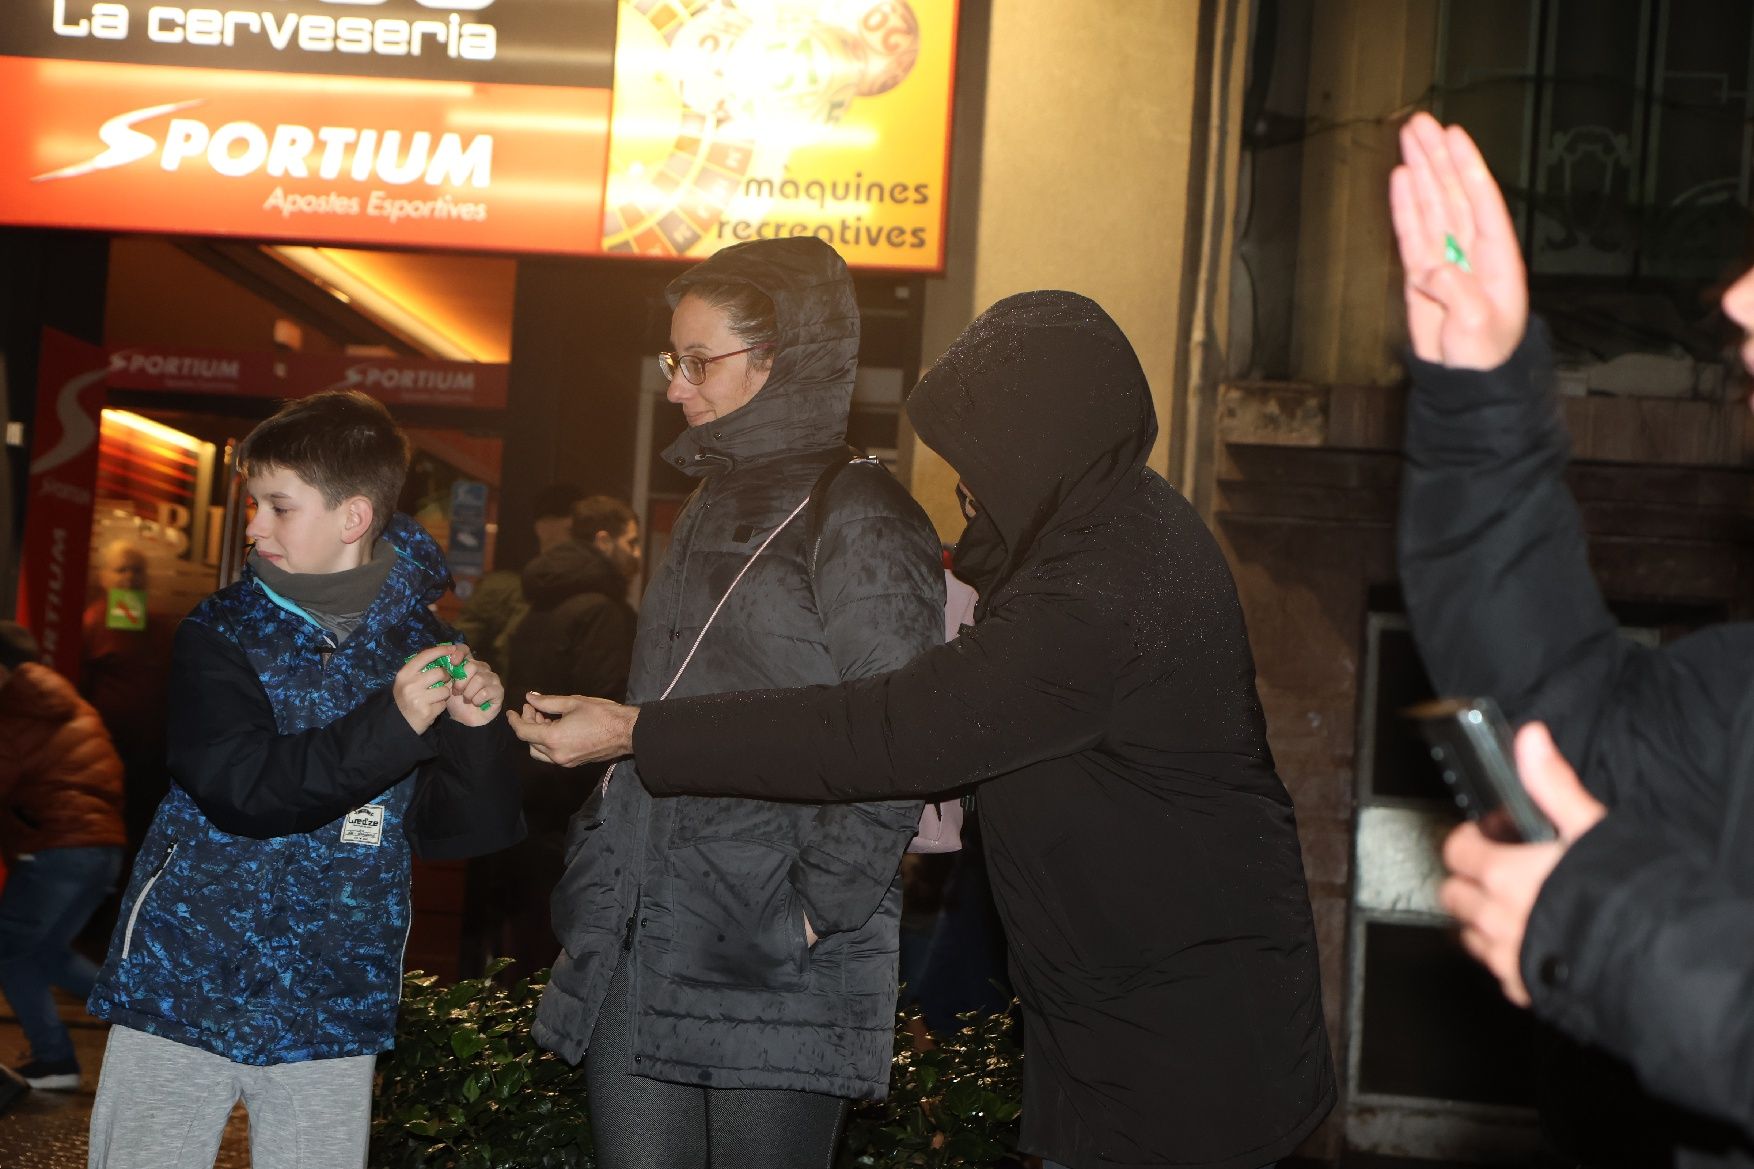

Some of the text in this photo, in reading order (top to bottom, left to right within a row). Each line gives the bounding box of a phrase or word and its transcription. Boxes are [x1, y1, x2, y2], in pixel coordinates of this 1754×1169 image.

[52, 1, 497, 61] La cerveseria
[30, 99, 494, 189] SPORTIUM
[263, 187, 487, 222] Apostes Esportives
[745, 172, 930, 209] maquines
[717, 216, 928, 249] recreatives
[106, 348, 241, 380] SPORTIUM
[338, 362, 476, 391] SPORTIUM
